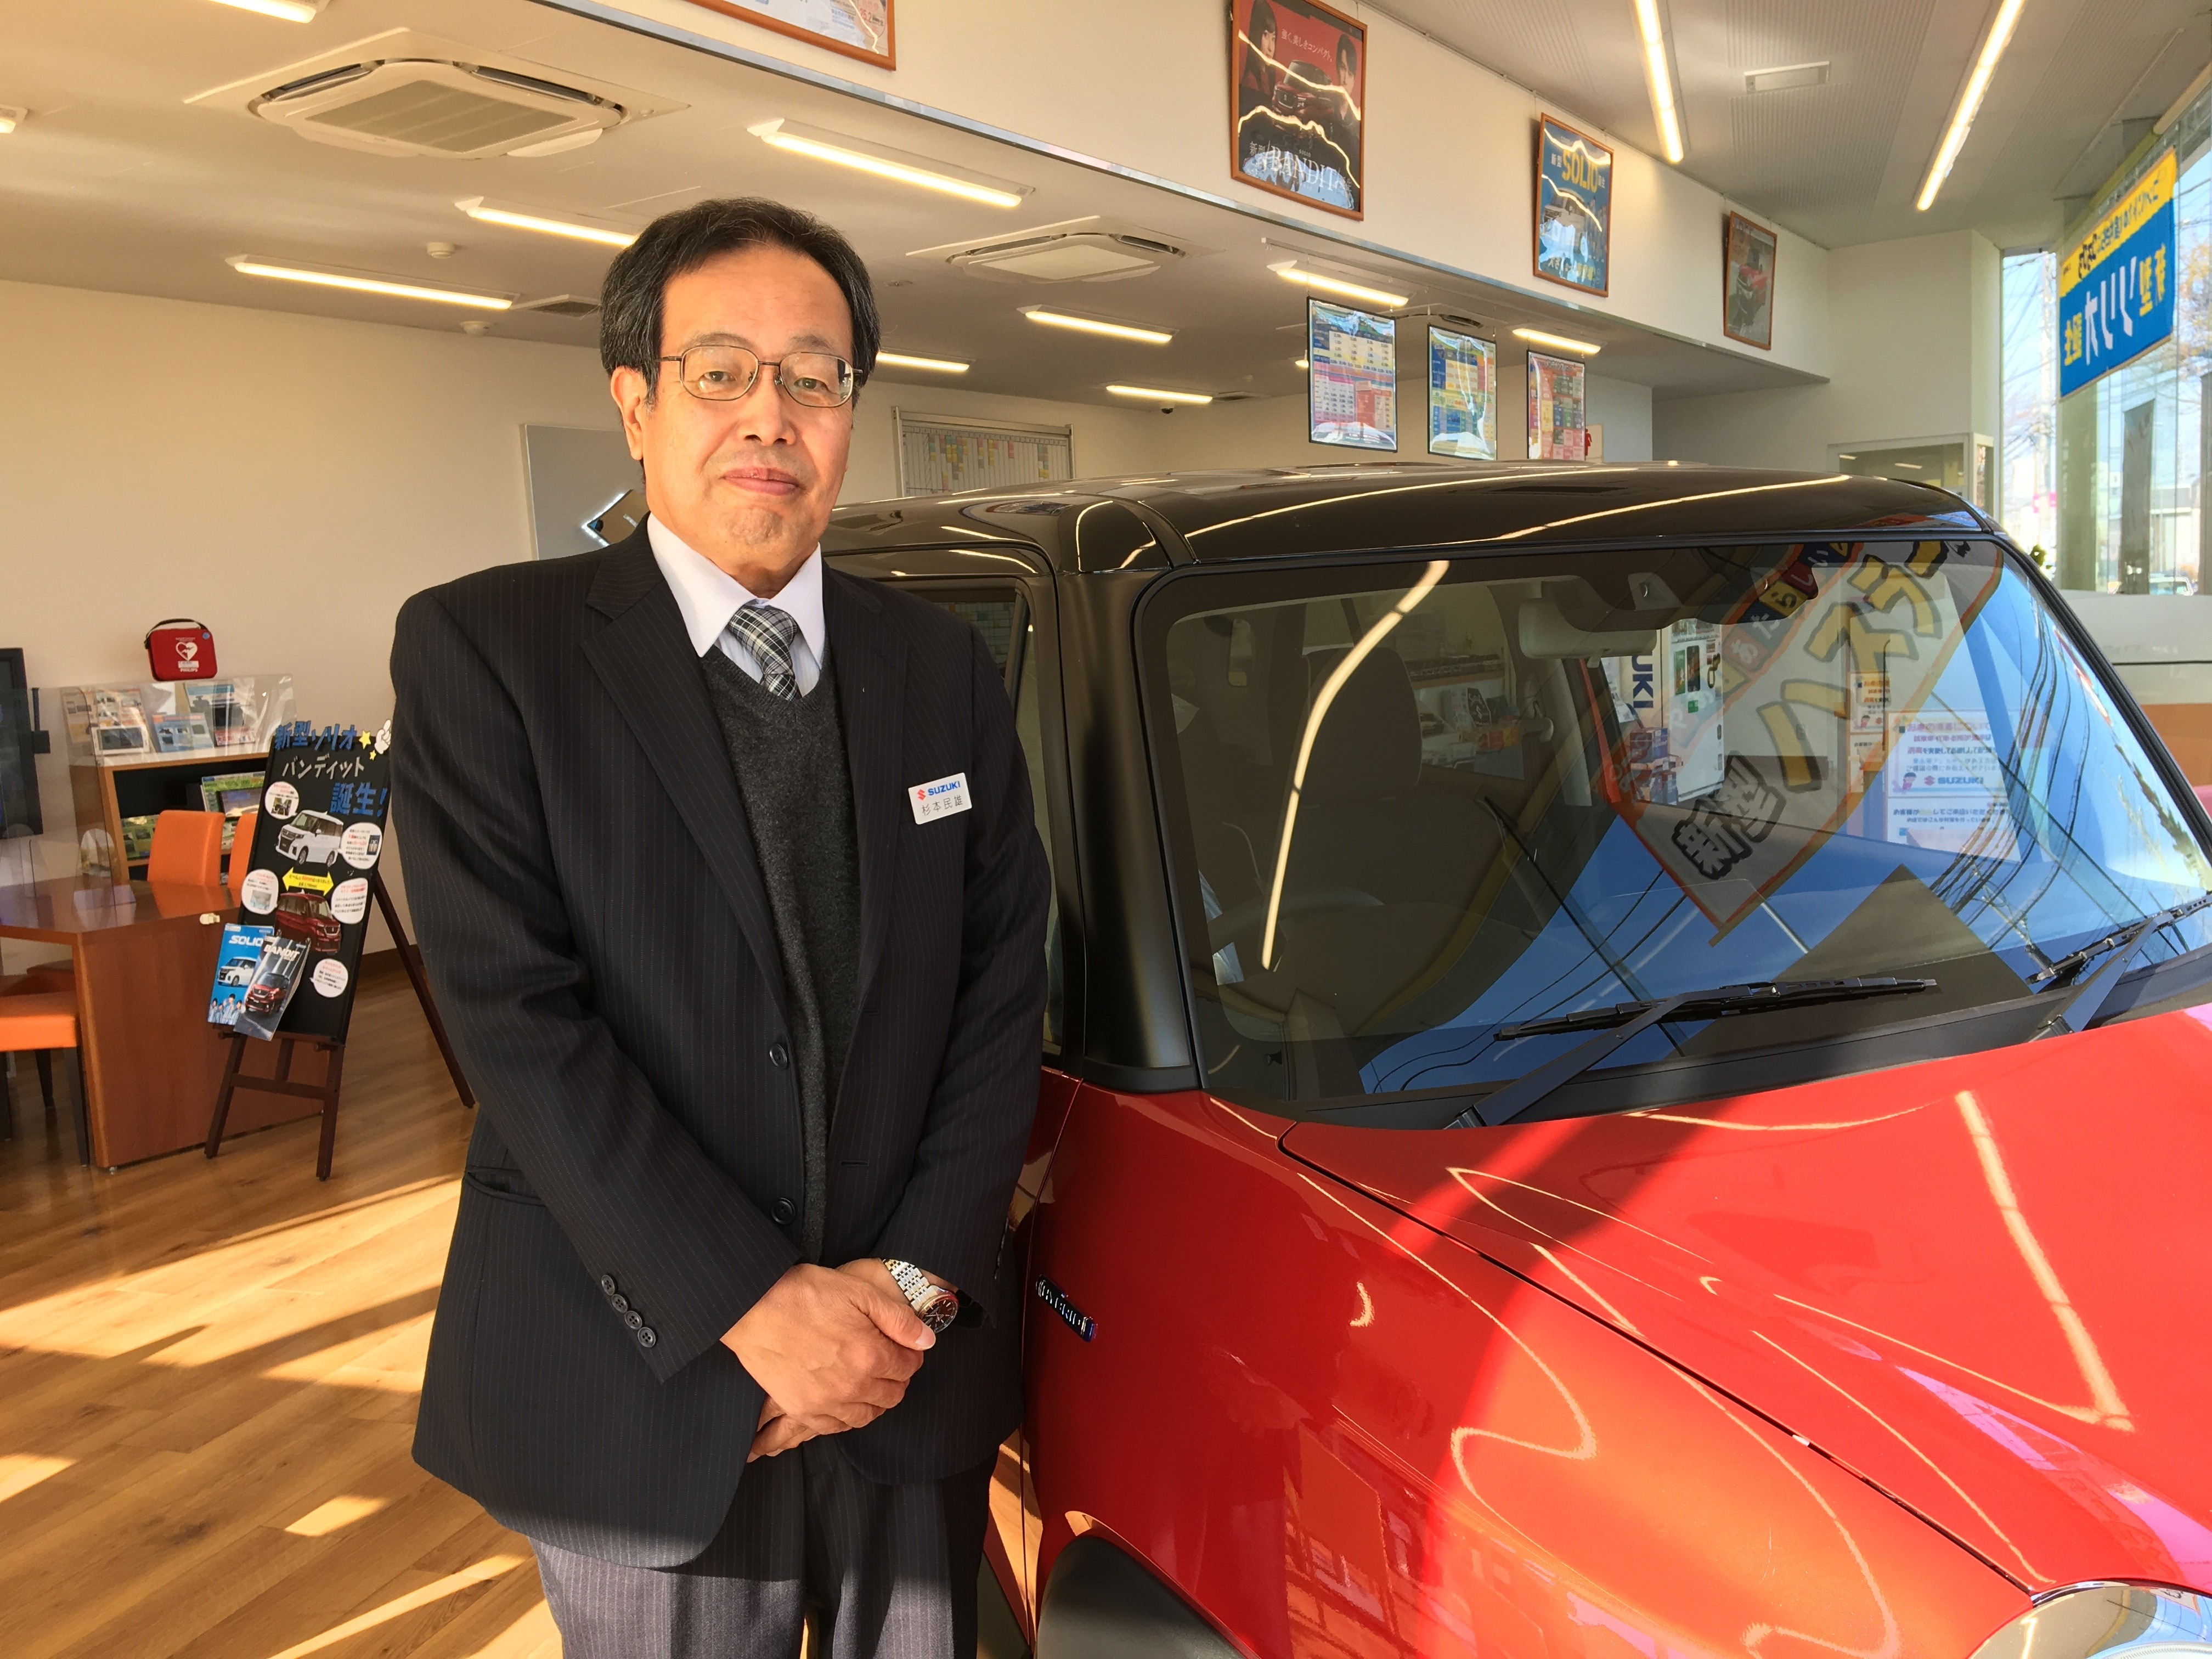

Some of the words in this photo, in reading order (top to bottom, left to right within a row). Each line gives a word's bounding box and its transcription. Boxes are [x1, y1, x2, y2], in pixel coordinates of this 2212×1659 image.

[1562, 149, 1598, 193] SOLIO
[275, 720, 357, 751] 新型ソリオ
[282, 753, 365, 780] バンディット
[928, 781, 961, 796] SUZUKI
[1938, 776, 1984, 785] SUZUKI
[921, 794, 963, 816] 杉本民雄
[228, 935, 263, 947] SOLIO
[263, 944, 301, 960] BANDIT
